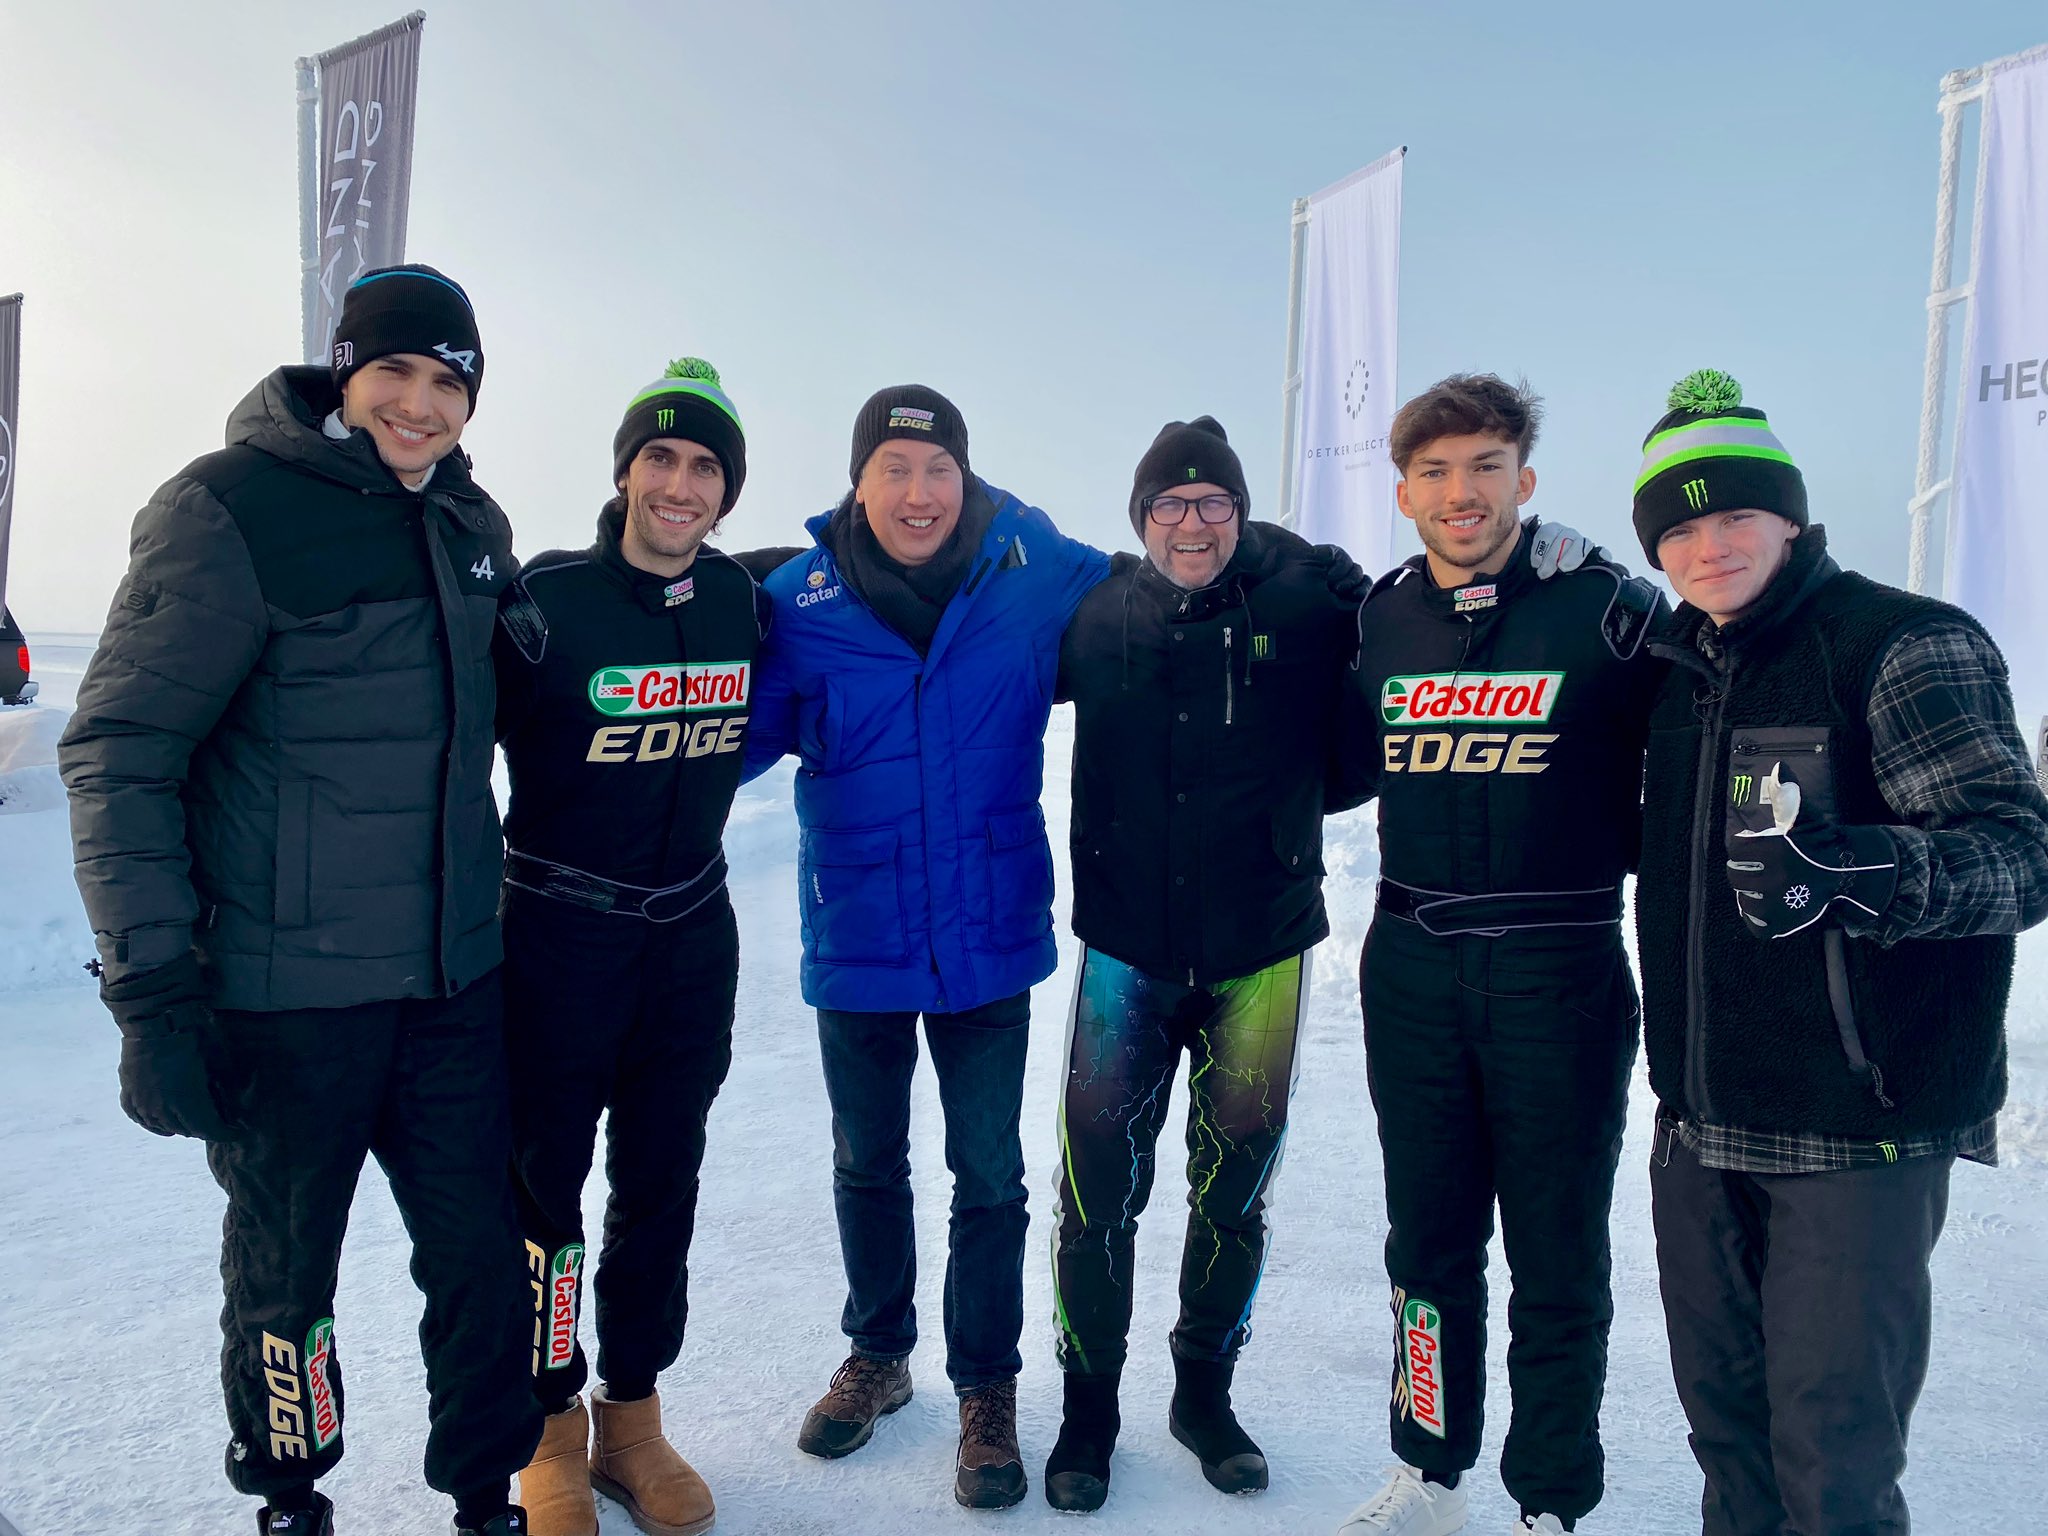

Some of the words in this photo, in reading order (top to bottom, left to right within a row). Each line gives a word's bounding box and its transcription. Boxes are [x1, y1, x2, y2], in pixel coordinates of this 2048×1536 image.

[1979, 358, 2048, 402] HE
[889, 417, 934, 431] EDGE
[901, 408, 931, 420] Castrol
[1307, 445, 1350, 459] OETKER
[1537, 540, 1547, 557] OMP
[796, 585, 840, 608] Qatar
[1455, 596, 1499, 612] EDGE
[1464, 586, 1494, 599] Castrol
[638, 667, 745, 710] Castrol
[1409, 677, 1548, 719] Castrol
[586, 716, 749, 763] EDGE
[1383, 732, 1561, 774] EDGE
[551, 1275, 577, 1365] Castrol
[262, 1330, 308, 1461] EDGE
[309, 1351, 337, 1443] Castrol
[1408, 1329, 1441, 1428] Castrol
